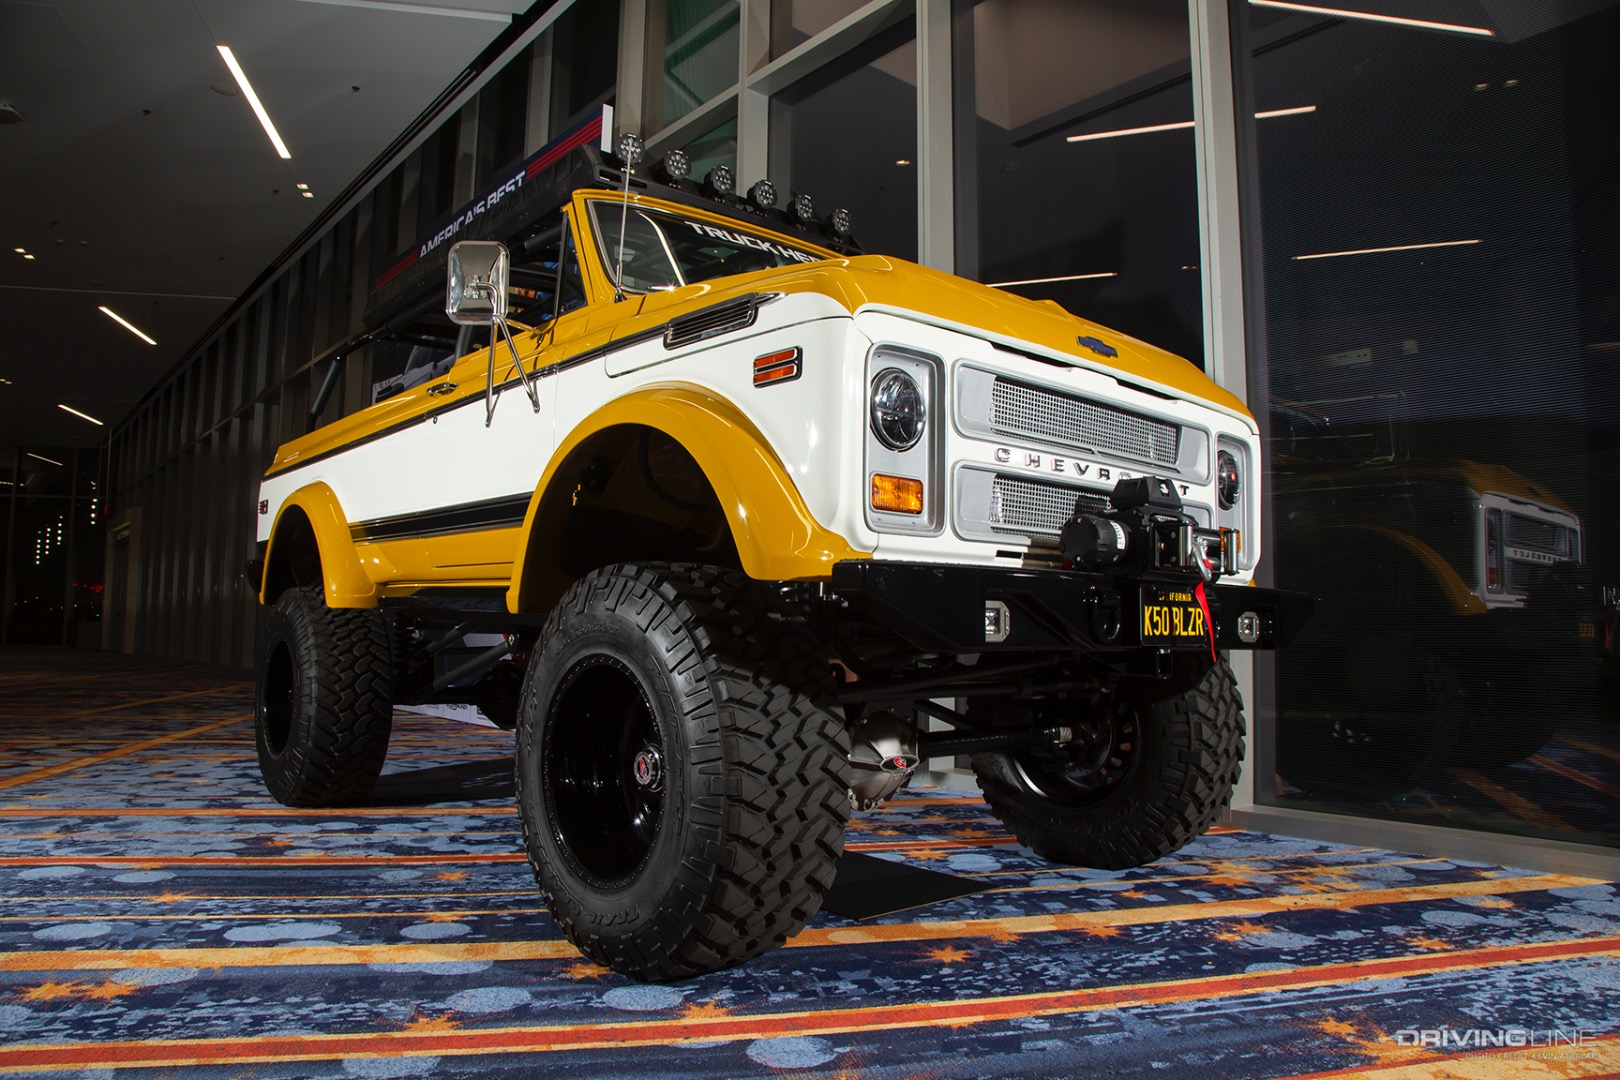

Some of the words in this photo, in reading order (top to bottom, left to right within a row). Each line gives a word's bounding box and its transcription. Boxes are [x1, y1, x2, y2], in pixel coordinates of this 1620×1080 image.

[684, 221, 779, 255] TRUCK
[1143, 605, 1170, 637] K50
[1173, 606, 1204, 637] BLZR
